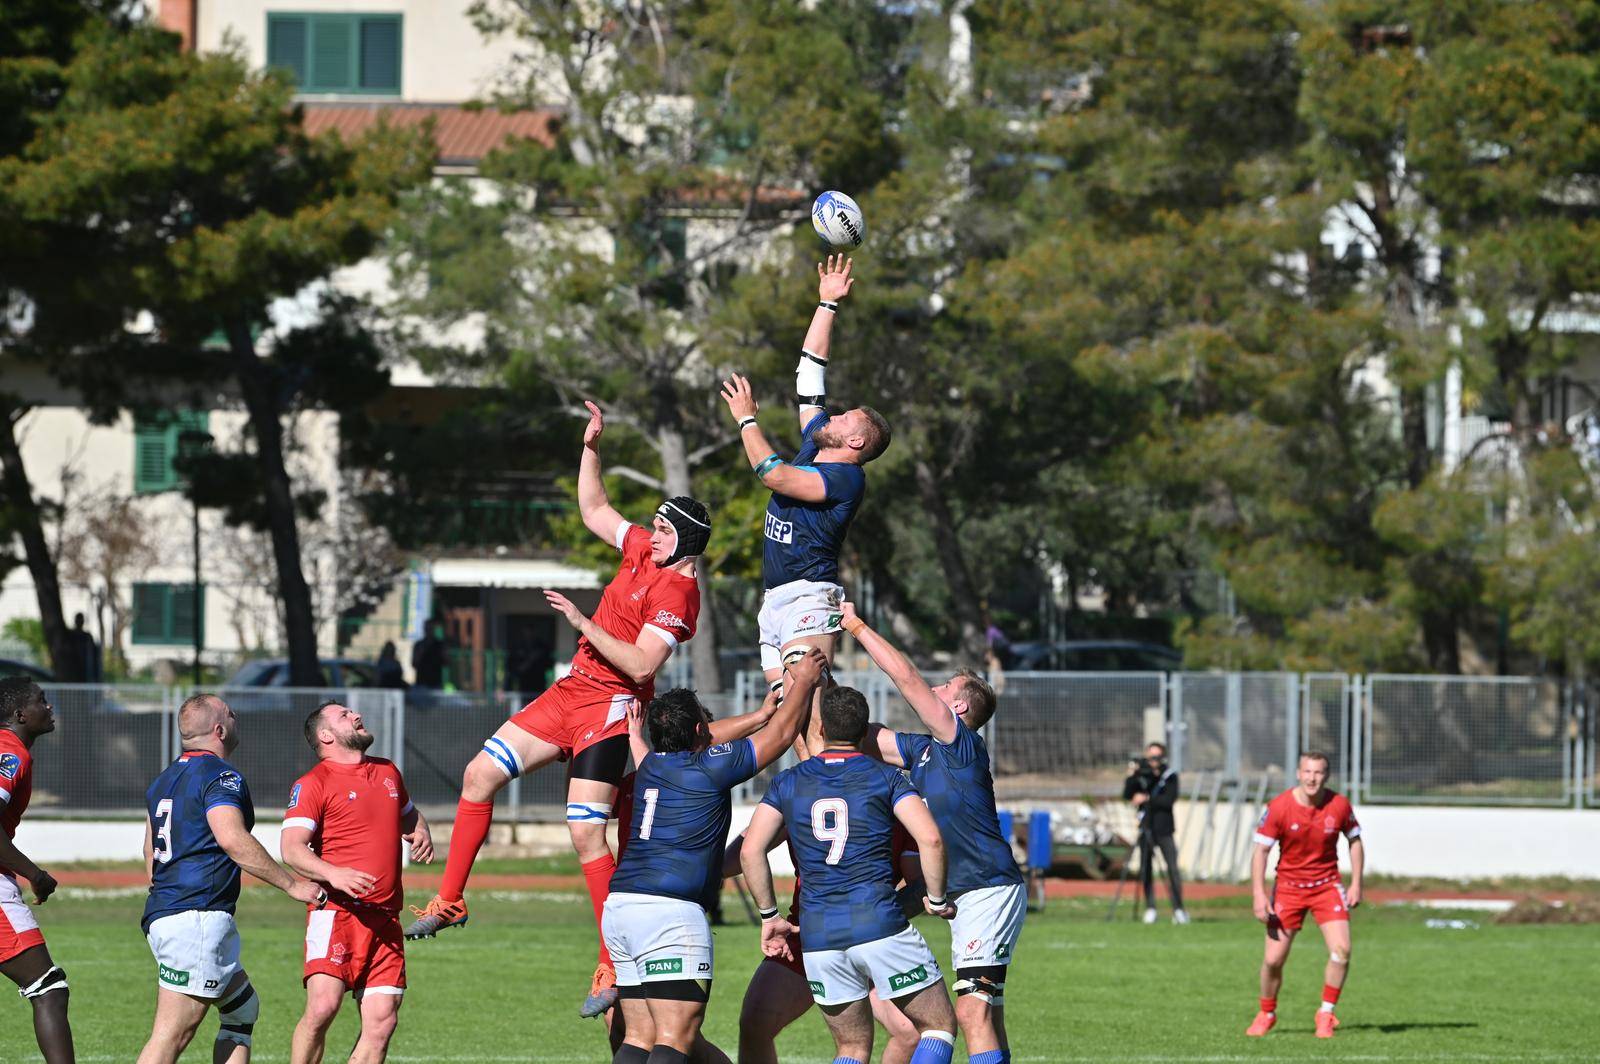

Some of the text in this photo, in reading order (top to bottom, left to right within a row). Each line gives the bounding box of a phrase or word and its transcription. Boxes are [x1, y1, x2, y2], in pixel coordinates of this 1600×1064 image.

[766, 513, 791, 541] HEP
[639, 788, 659, 840] 1
[153, 798, 173, 863] 3
[811, 797, 849, 865] 9
[160, 968, 179, 981] PAN
[649, 962, 672, 971] PAN
[894, 972, 920, 987] PAN
